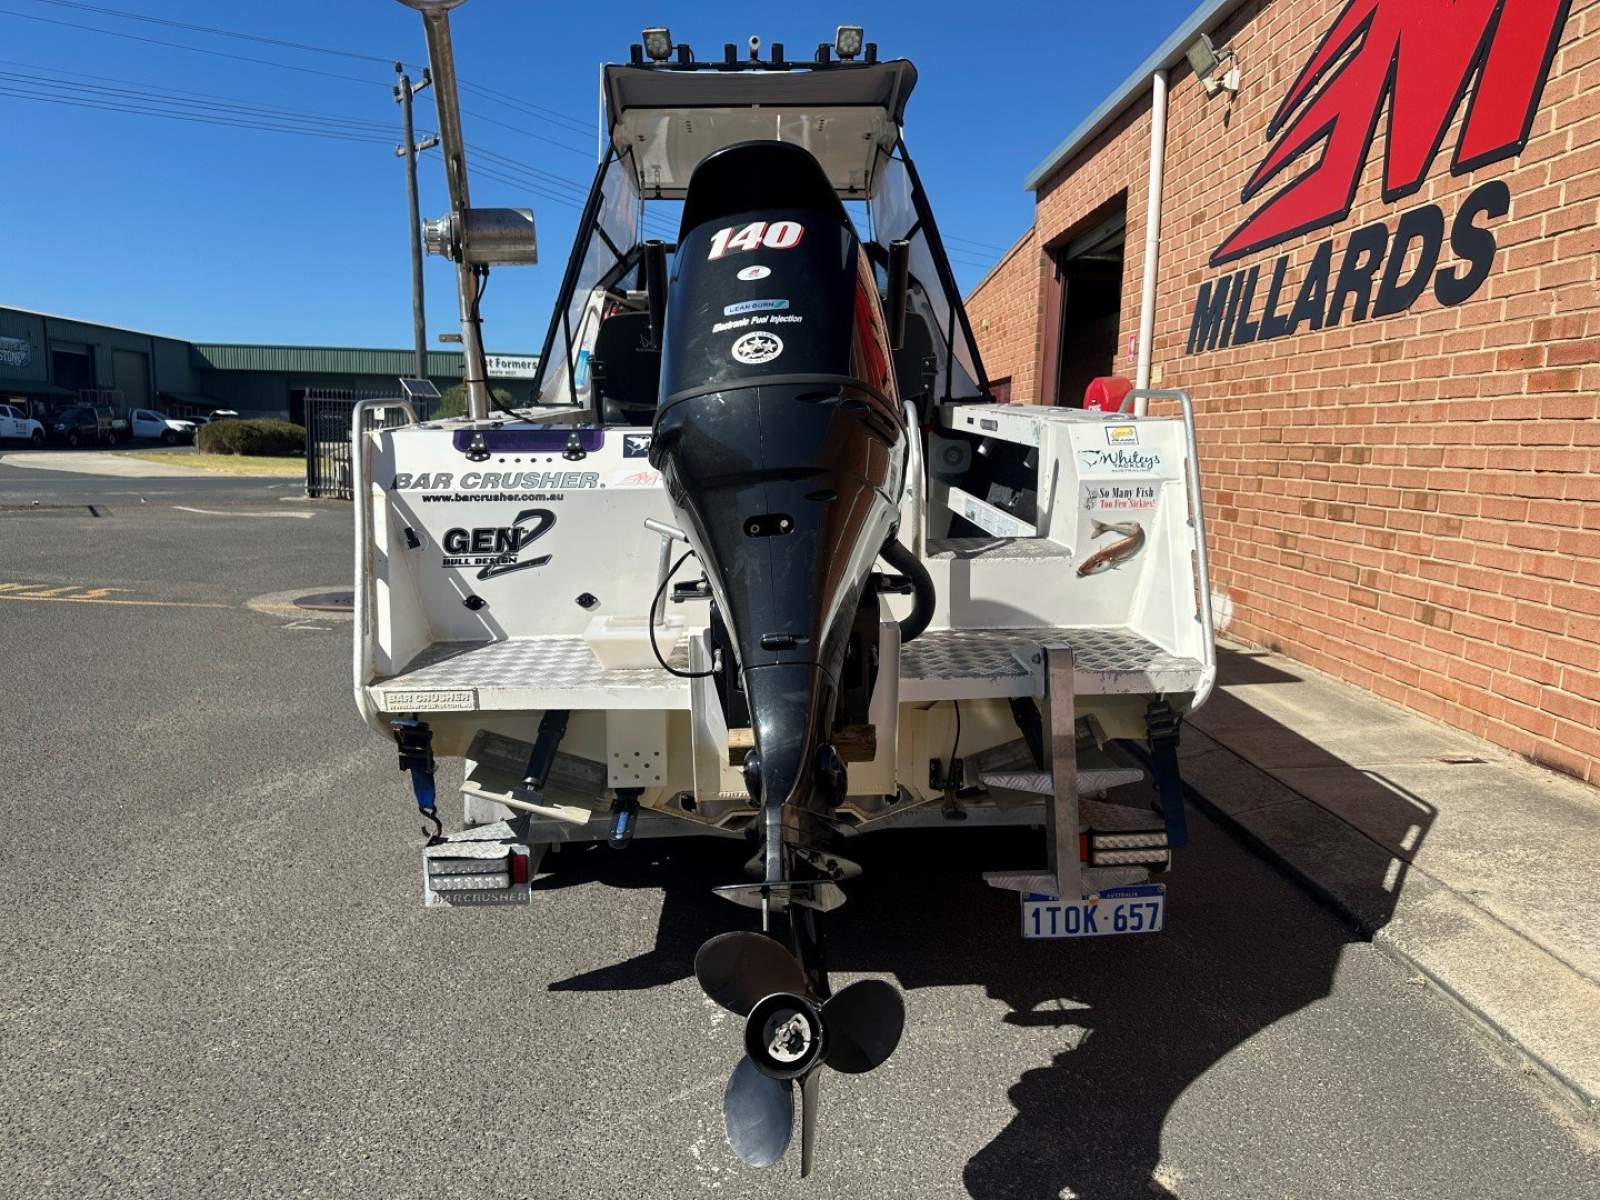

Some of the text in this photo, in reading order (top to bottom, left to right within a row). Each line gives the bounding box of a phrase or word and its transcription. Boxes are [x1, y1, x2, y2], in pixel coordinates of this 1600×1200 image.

[707, 220, 805, 261] 140
[1186, 180, 1511, 356] MILLARDS
[729, 301, 774, 313] LEAN BURN
[712, 314, 803, 333] Electronic Fuel Injection
[1099, 449, 1161, 470] Whiteys
[391, 472, 453, 490] BAR
[421, 492, 564, 503] www.barcrusher.com.au
[1099, 486, 1154, 501] So Many Fish
[1100, 499, 1113, 509] Too
[1115, 499, 1127, 508] Few
[442, 526, 521, 554] GEN
[441, 555, 518, 566] HULL DESIGN
[389, 692, 471, 704] BAR CRUSHER
[463, 891, 528, 903] CRUSHER
